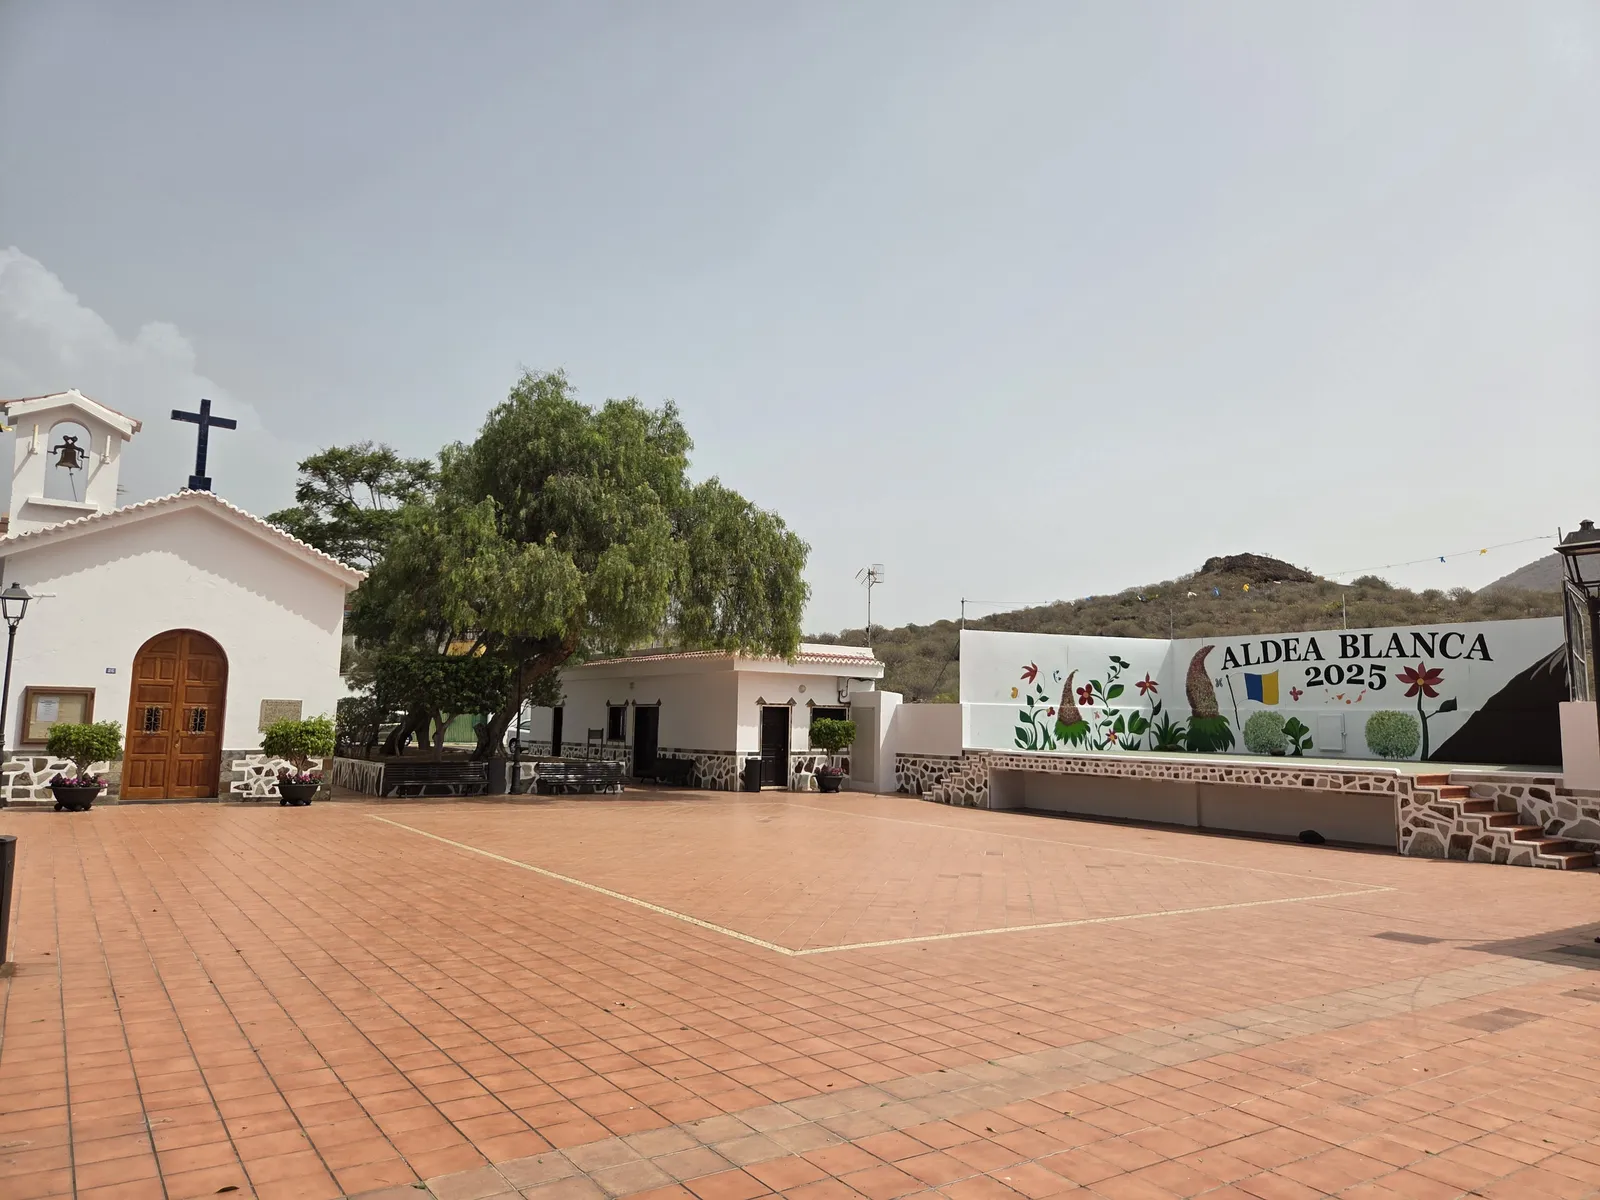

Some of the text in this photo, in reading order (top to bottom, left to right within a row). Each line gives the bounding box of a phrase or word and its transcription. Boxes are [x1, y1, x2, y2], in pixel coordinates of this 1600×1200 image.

[1221, 632, 1493, 671] ALDEA BLANCA
[1304, 663, 1387, 691] 2025
